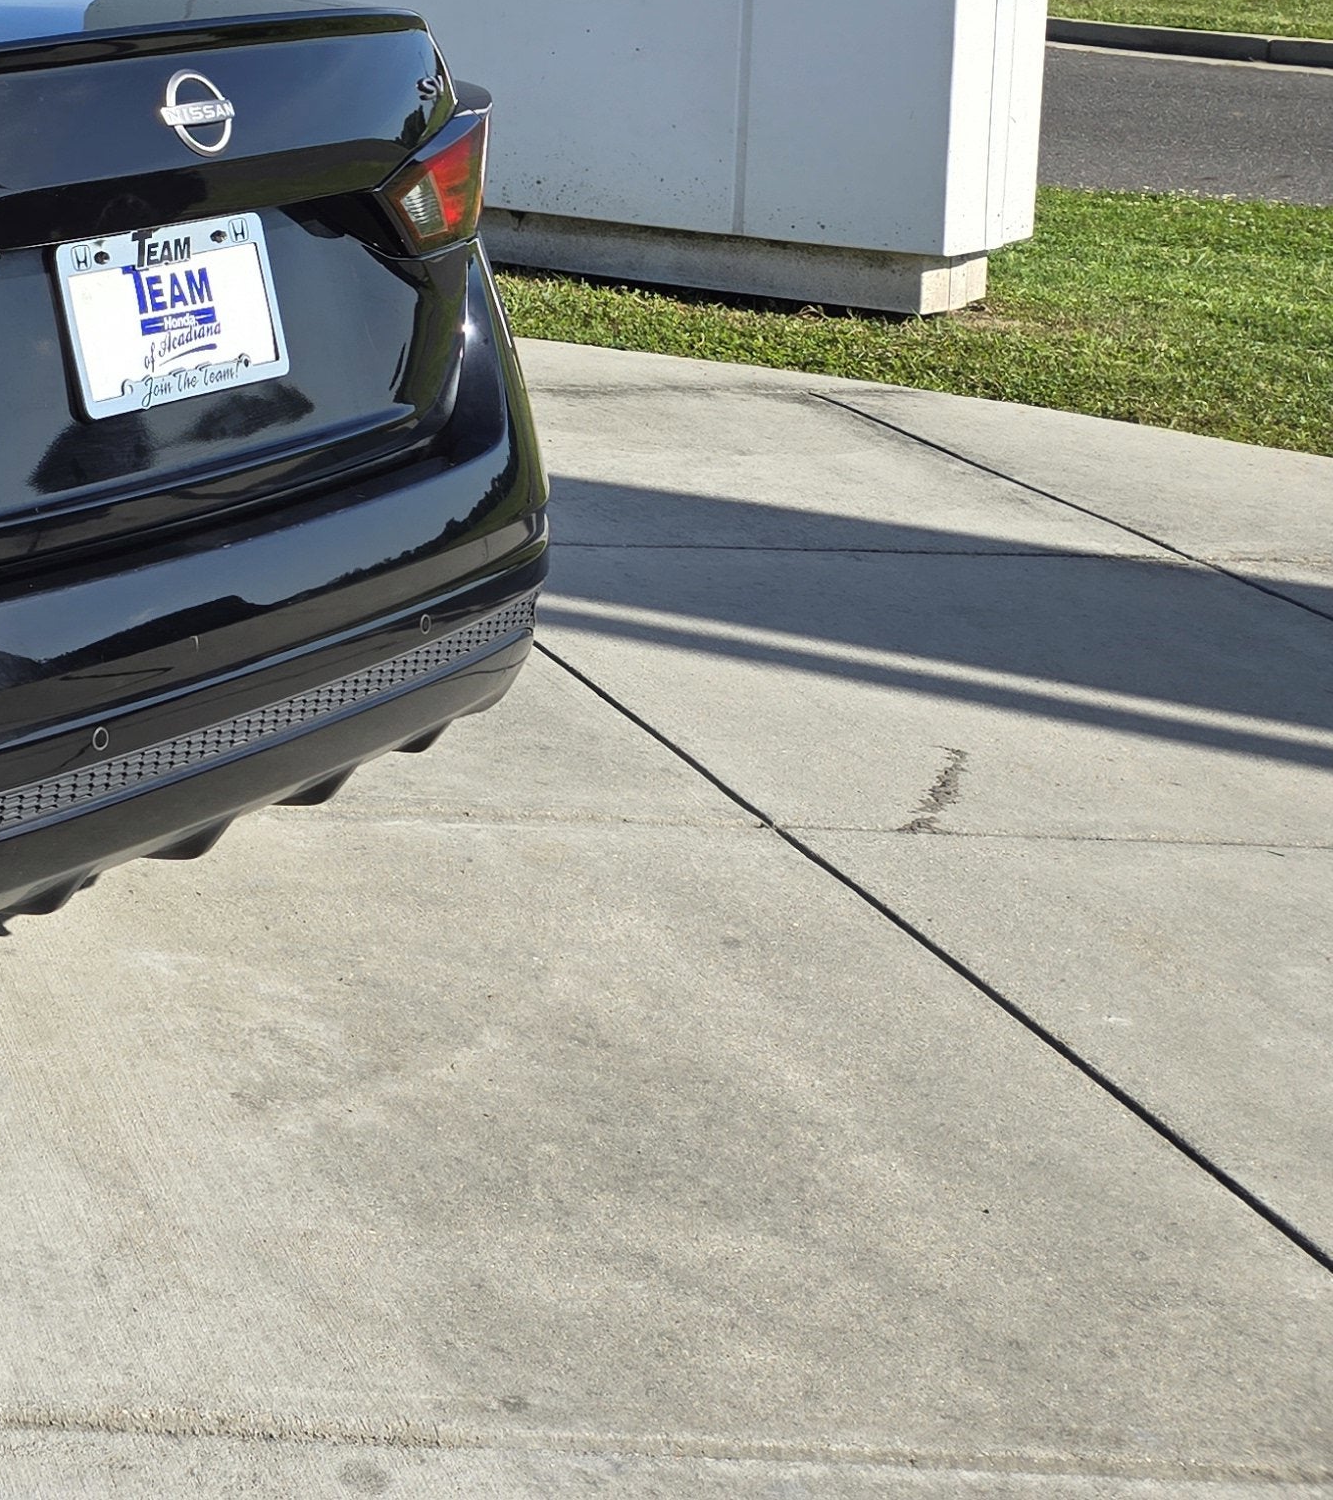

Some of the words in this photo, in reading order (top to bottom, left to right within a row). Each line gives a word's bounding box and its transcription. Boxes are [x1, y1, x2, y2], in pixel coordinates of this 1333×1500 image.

[165, 99, 235, 124] NISSAN
[131, 229, 191, 267] TEAM
[121, 265, 214, 315] TEAM
[163, 313, 197, 331] Honda
[144, 342, 156, 373] of
[159, 322, 221, 357] Acadiana
[141, 376, 172, 407] Join
[173, 369, 199, 392] The
